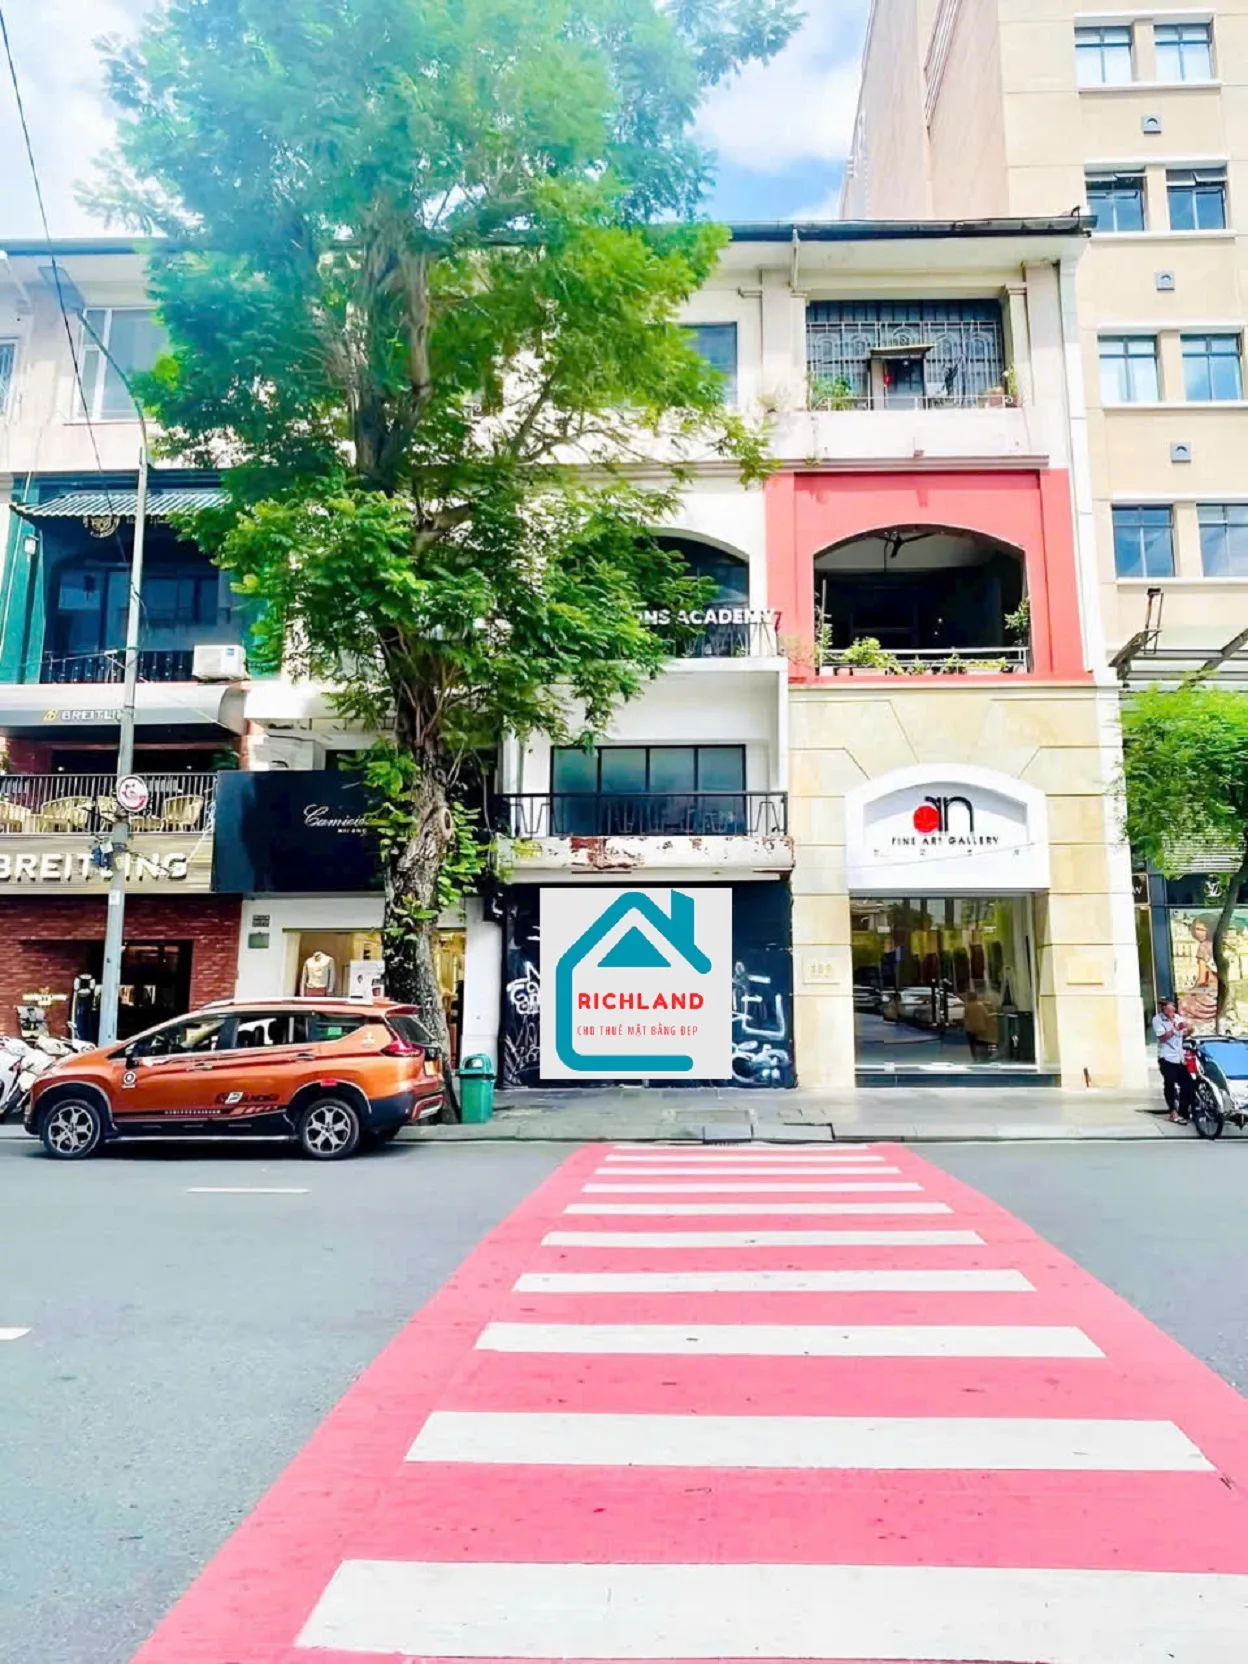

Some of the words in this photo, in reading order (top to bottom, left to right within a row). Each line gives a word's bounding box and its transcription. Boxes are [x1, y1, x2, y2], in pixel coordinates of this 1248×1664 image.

[636, 609, 671, 625] NS
[891, 837, 916, 846] FINE
[922, 837, 943, 846] ART
[948, 836, 999, 846] GALLERY
